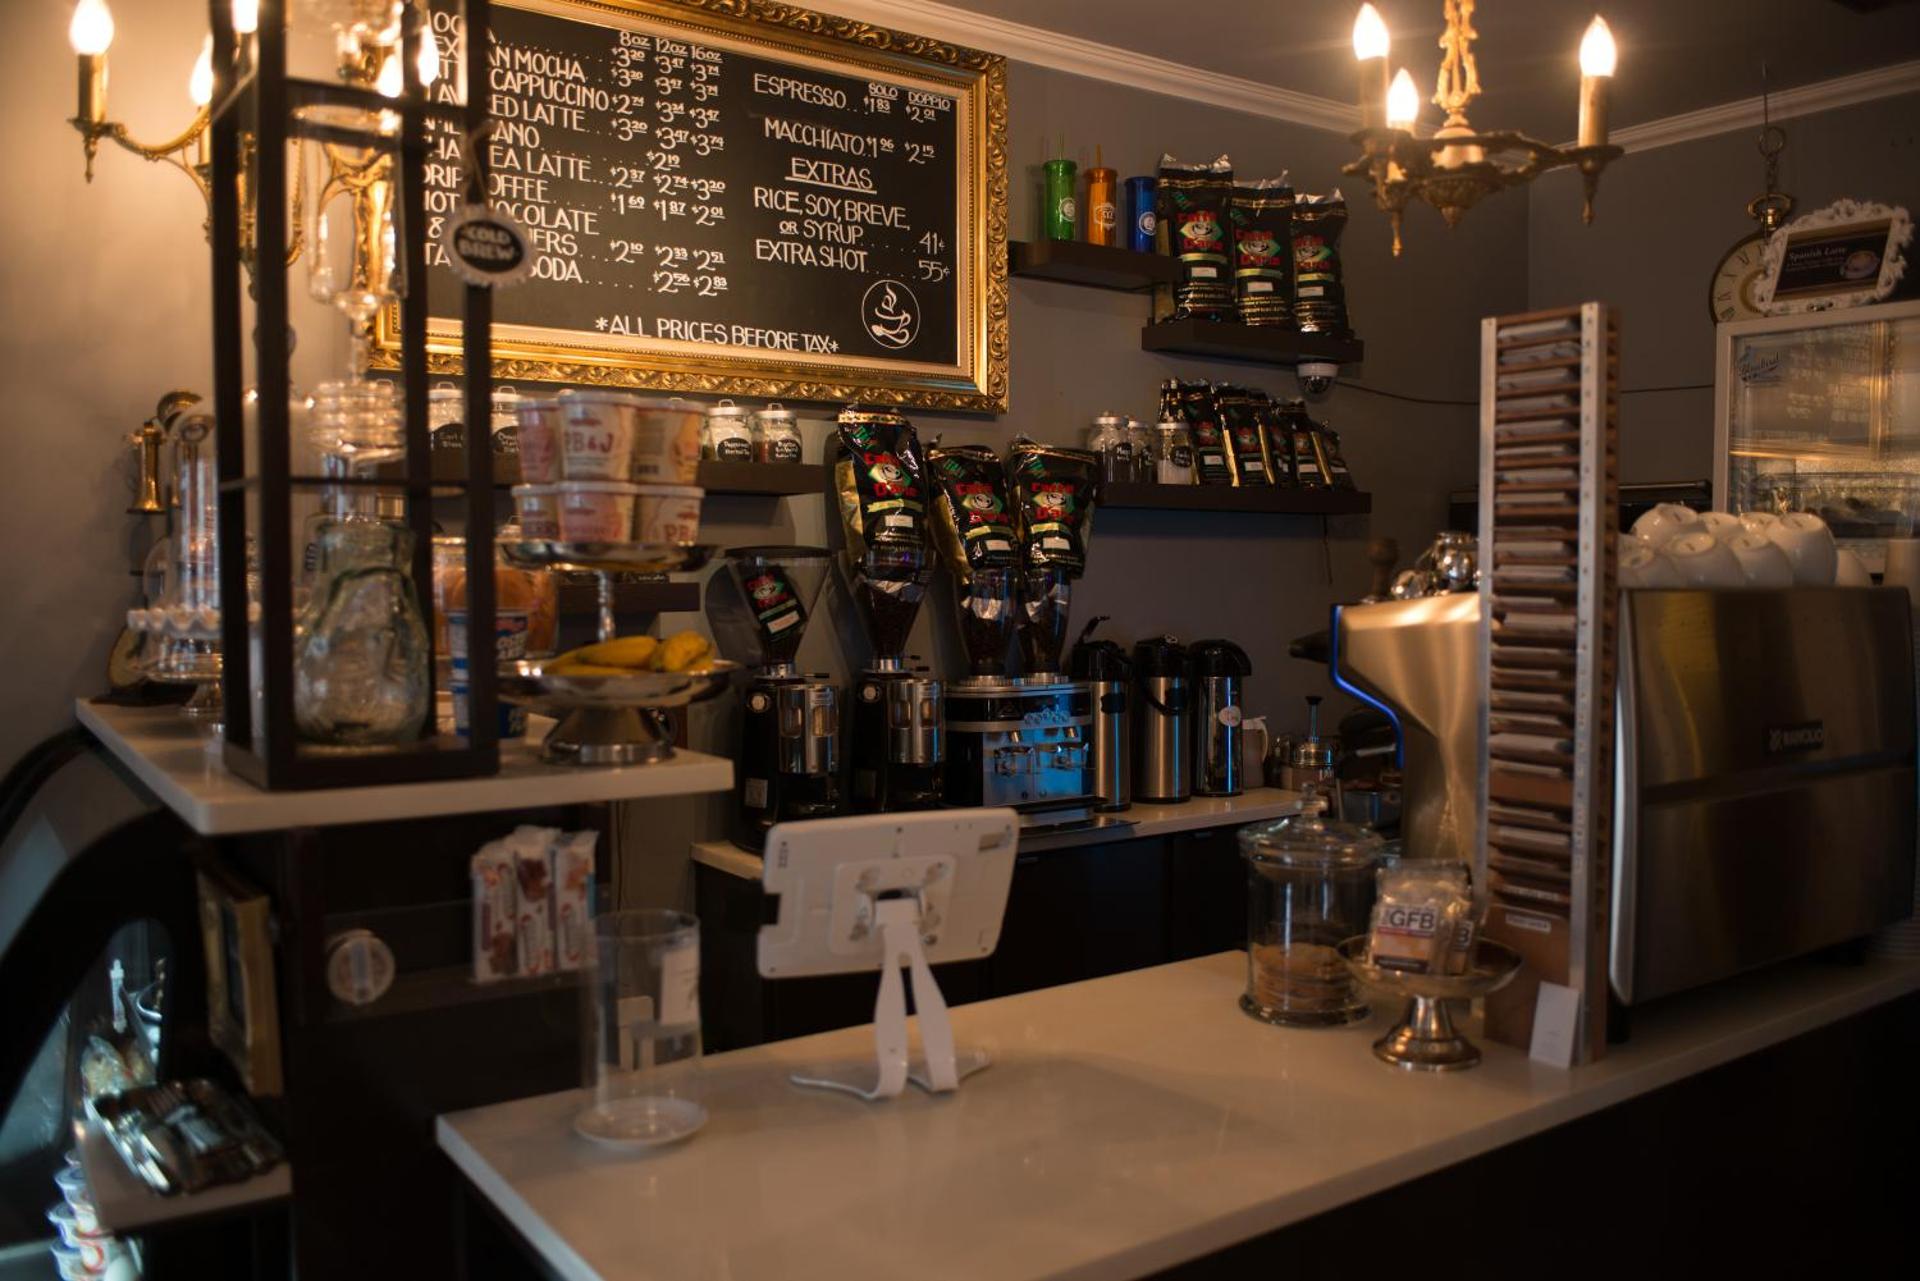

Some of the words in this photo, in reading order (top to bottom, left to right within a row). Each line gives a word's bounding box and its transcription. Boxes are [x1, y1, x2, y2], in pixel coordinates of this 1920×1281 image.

[515, 48, 586, 83] MOCHA
[490, 68, 609, 111] CAPPUCCINO
[754, 73, 846, 109] ESPRESSO
[868, 82, 898, 99] SOLO
[908, 91, 950, 111] DOPPIO
[523, 99, 585, 131] LATTE
[765, 117, 864, 155] MACCHIATO
[527, 151, 592, 182] LATTE
[791, 157, 873, 190] EXTRAS
[803, 219, 863, 245] SYRUP
[756, 239, 818, 266] EXTRA
[820, 246, 868, 272] SHOT
[656, 318, 728, 345] PRICES
[731, 325, 799, 351] BEFORE
[1390, 909, 1435, 930] GFB
